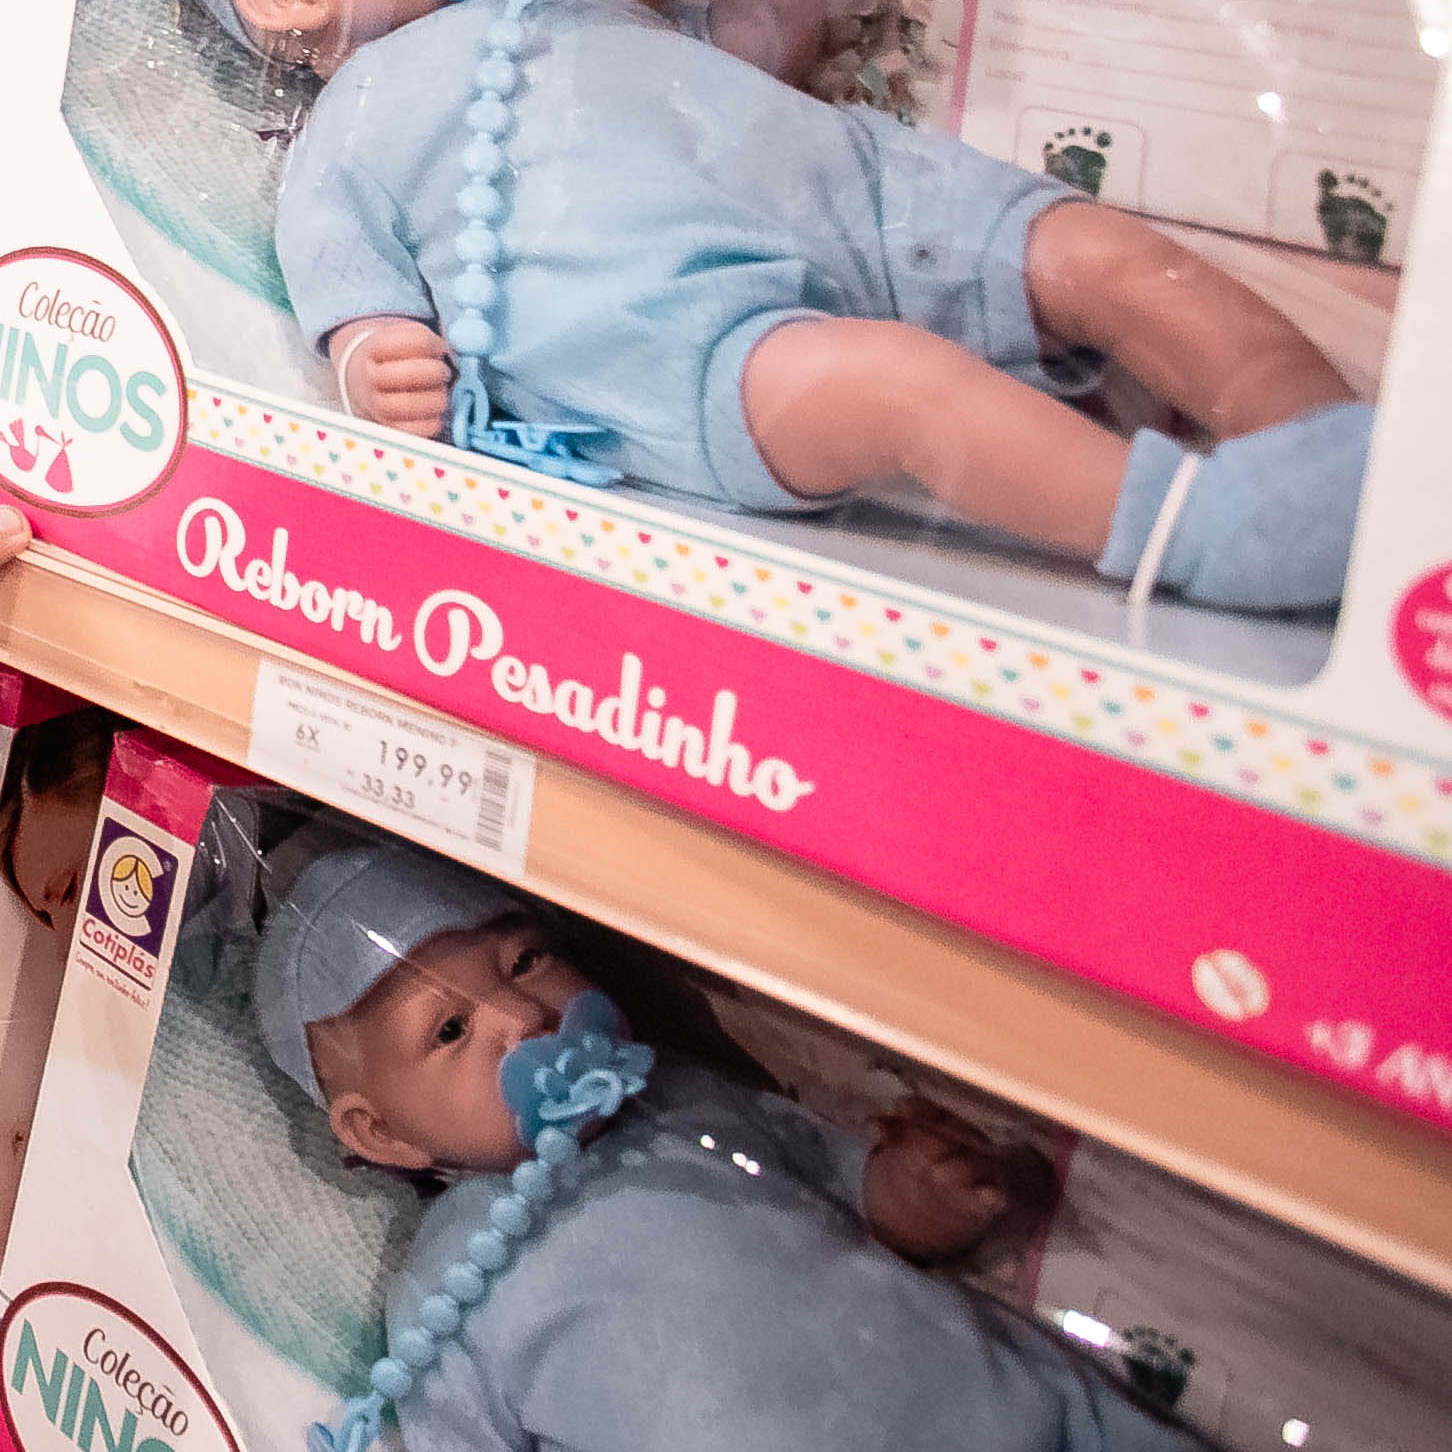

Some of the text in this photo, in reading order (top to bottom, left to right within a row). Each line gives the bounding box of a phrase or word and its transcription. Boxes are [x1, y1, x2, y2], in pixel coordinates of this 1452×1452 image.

[17, 279, 118, 349] Coleção
[174, 496, 817, 814] Reborn Pesadinho
[295, 722, 321, 748] 6X
[379, 739, 474, 798] 199,99
[81, 918, 157, 981] Cotiplás
[10, 1318, 179, 1452] NIN
[82, 1327, 191, 1438] Coleção
